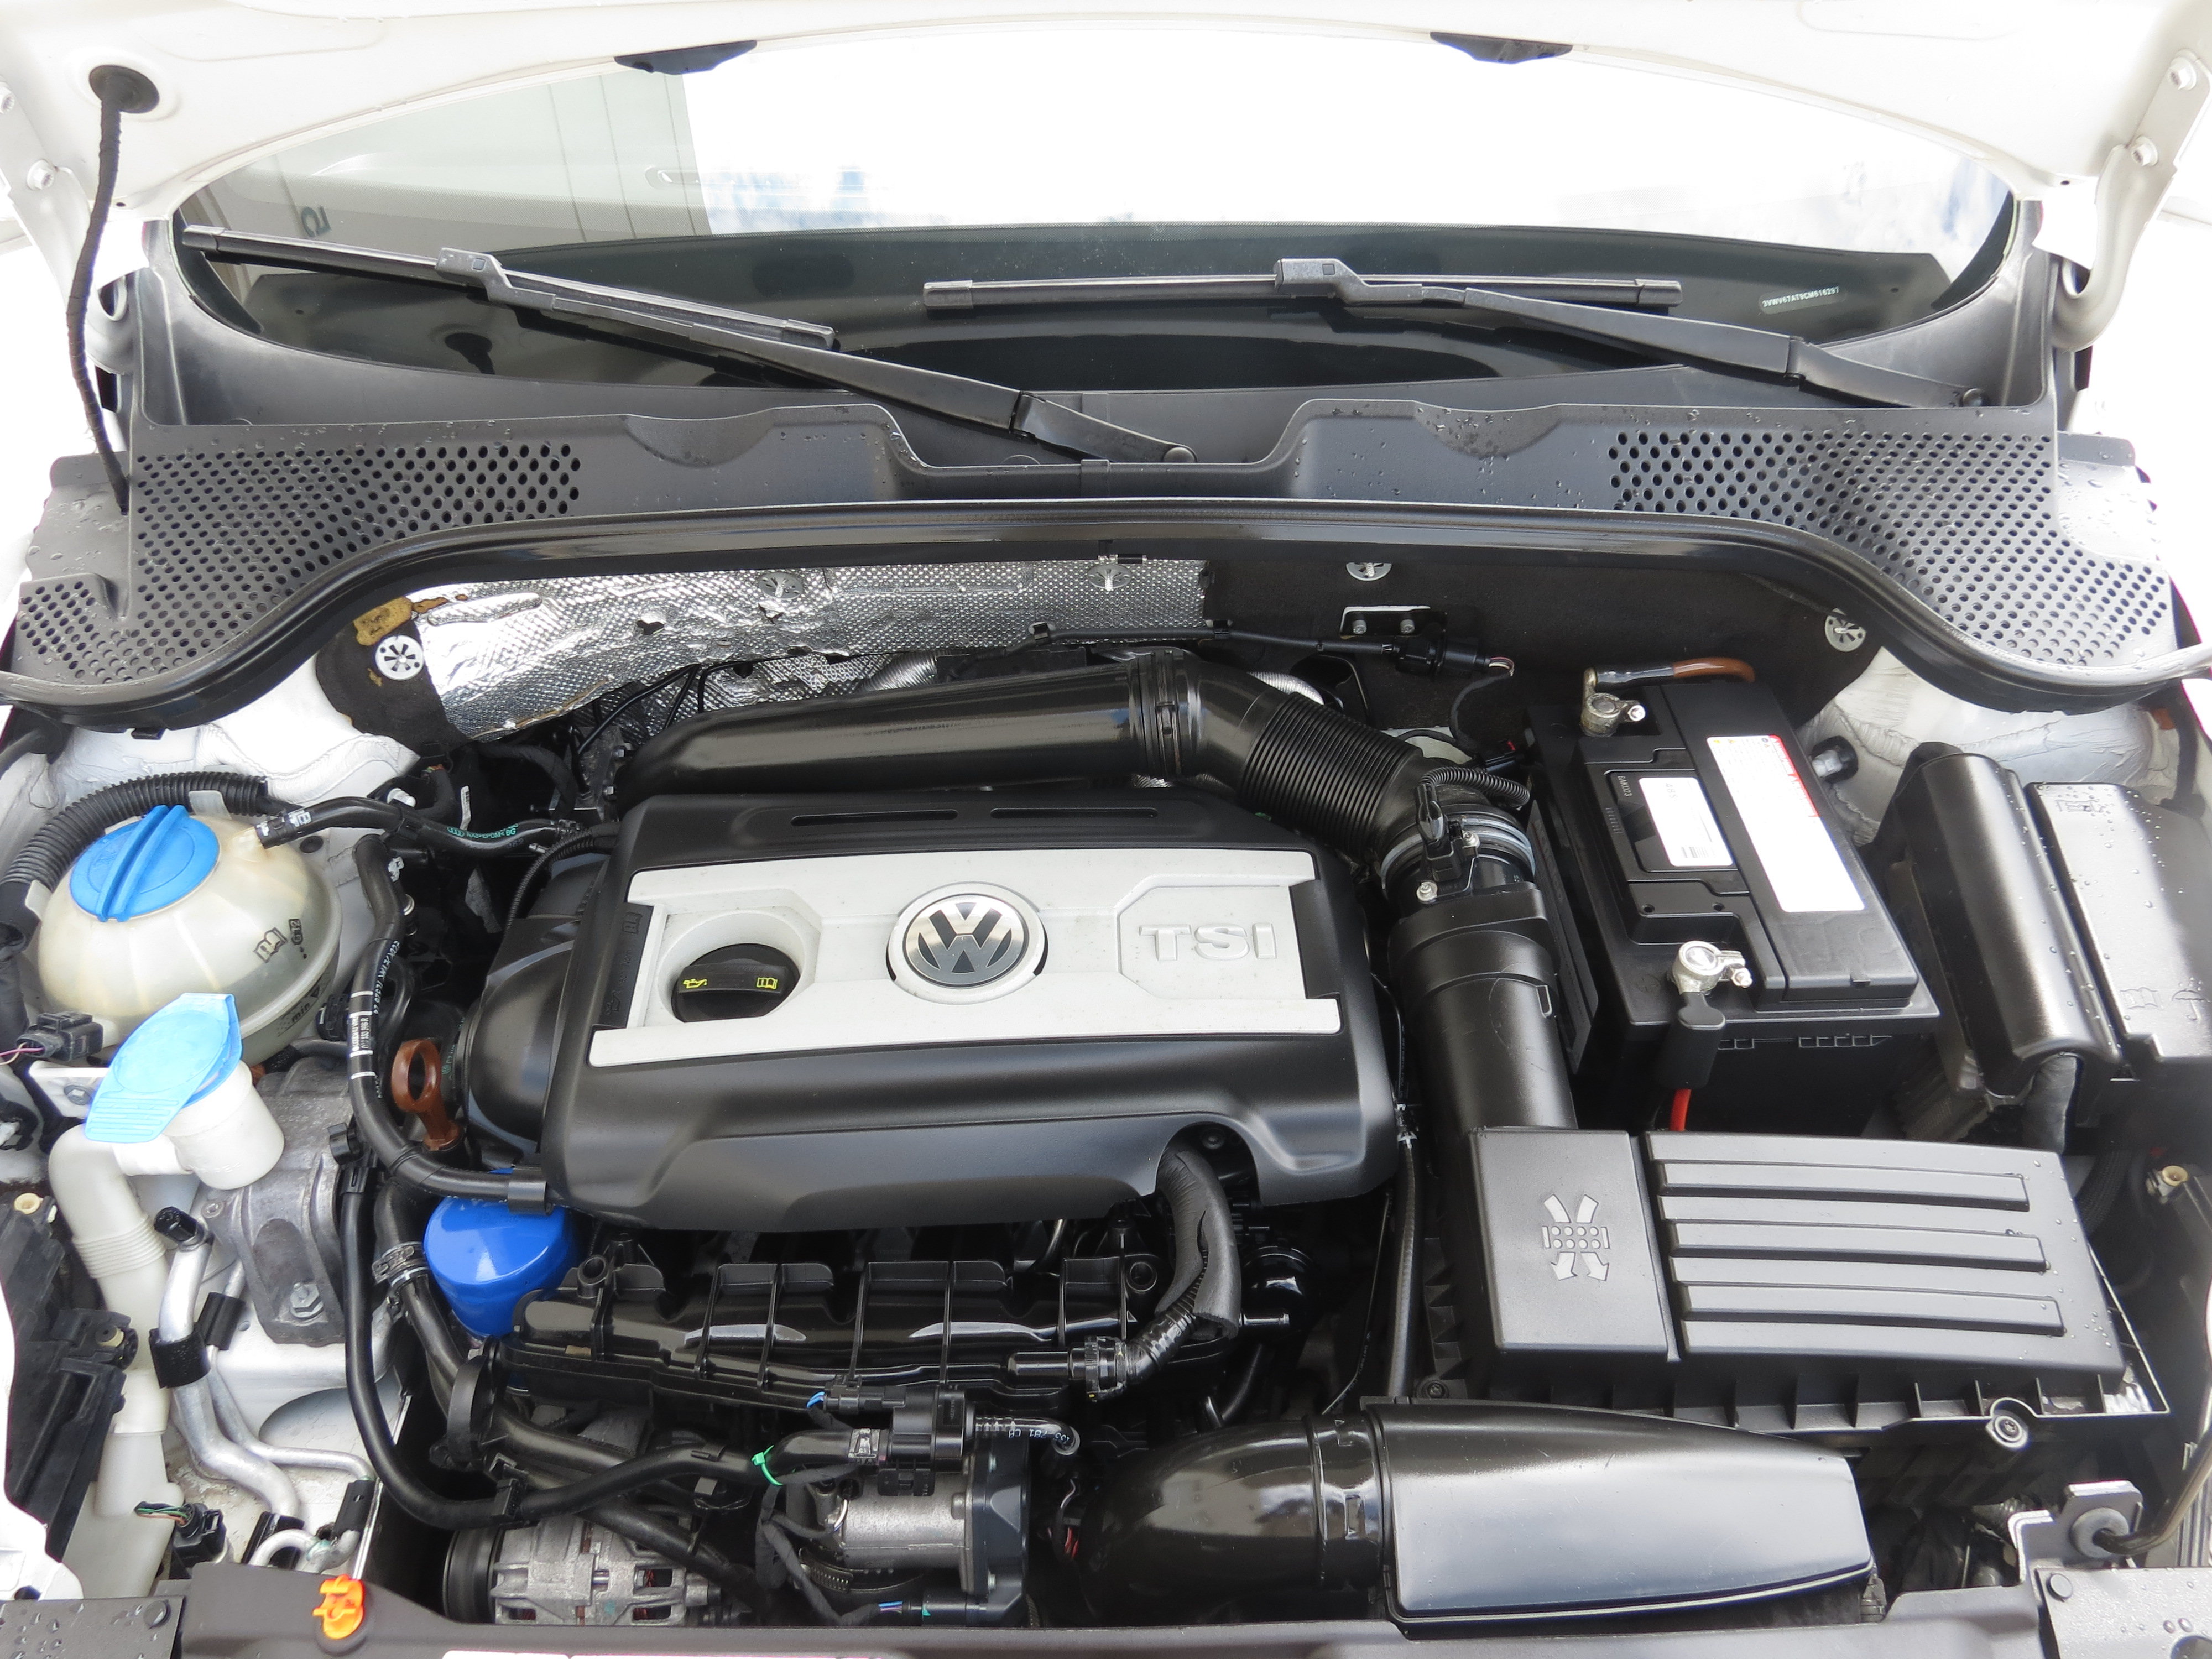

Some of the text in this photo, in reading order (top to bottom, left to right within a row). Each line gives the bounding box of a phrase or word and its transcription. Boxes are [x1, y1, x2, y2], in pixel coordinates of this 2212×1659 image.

[902, 893, 1030, 989] VW
[1139, 922, 1277, 961] TSI
[291, 1002, 311, 1024] min
